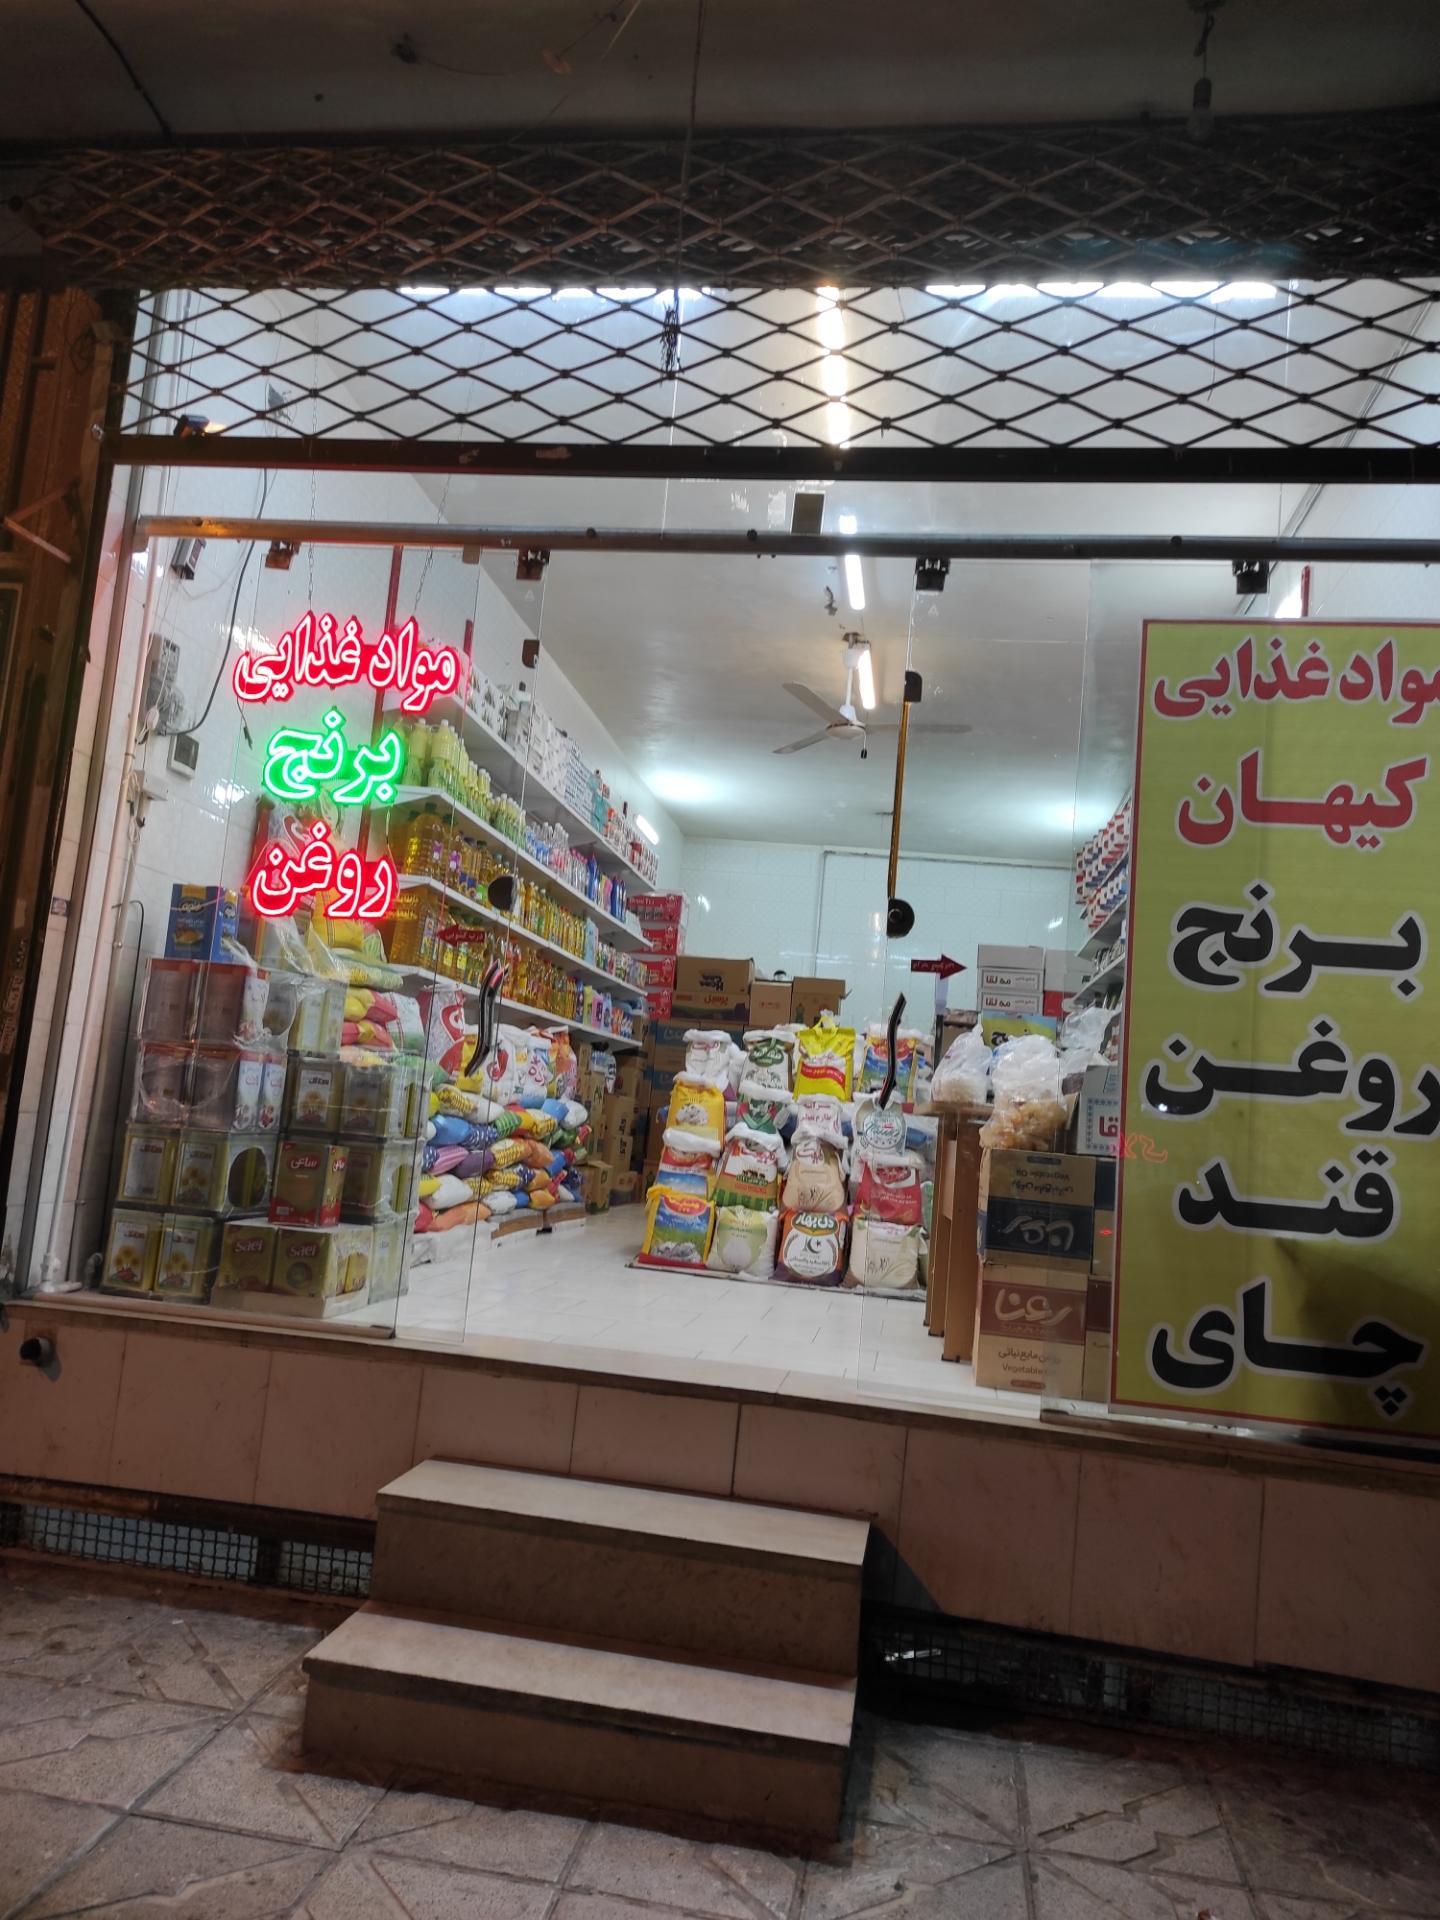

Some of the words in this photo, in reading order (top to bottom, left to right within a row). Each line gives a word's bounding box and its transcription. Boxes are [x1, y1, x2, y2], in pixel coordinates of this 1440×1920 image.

[235, 612, 361, 701] غذایی
[370, 617, 458, 712] مواد
[1154, 637, 1330, 718] غذایی
[264, 709, 405, 804] برنج
[1178, 750, 1427, 849] کیهان
[253, 822, 393, 917] روغن
[1173, 884, 1421, 996] برنج
[1145, 1020, 1440, 1135] روغن
[290, 1156, 317, 1169] ساعی
[1178, 1149, 1394, 1237] قند
[1003, 1216, 1074, 1251] رعنا
[995, 1289, 1073, 1326] رعنا
[1152, 1281, 1424, 1416] چای
[1002, 1362, 1043, 1375] Vegetable
